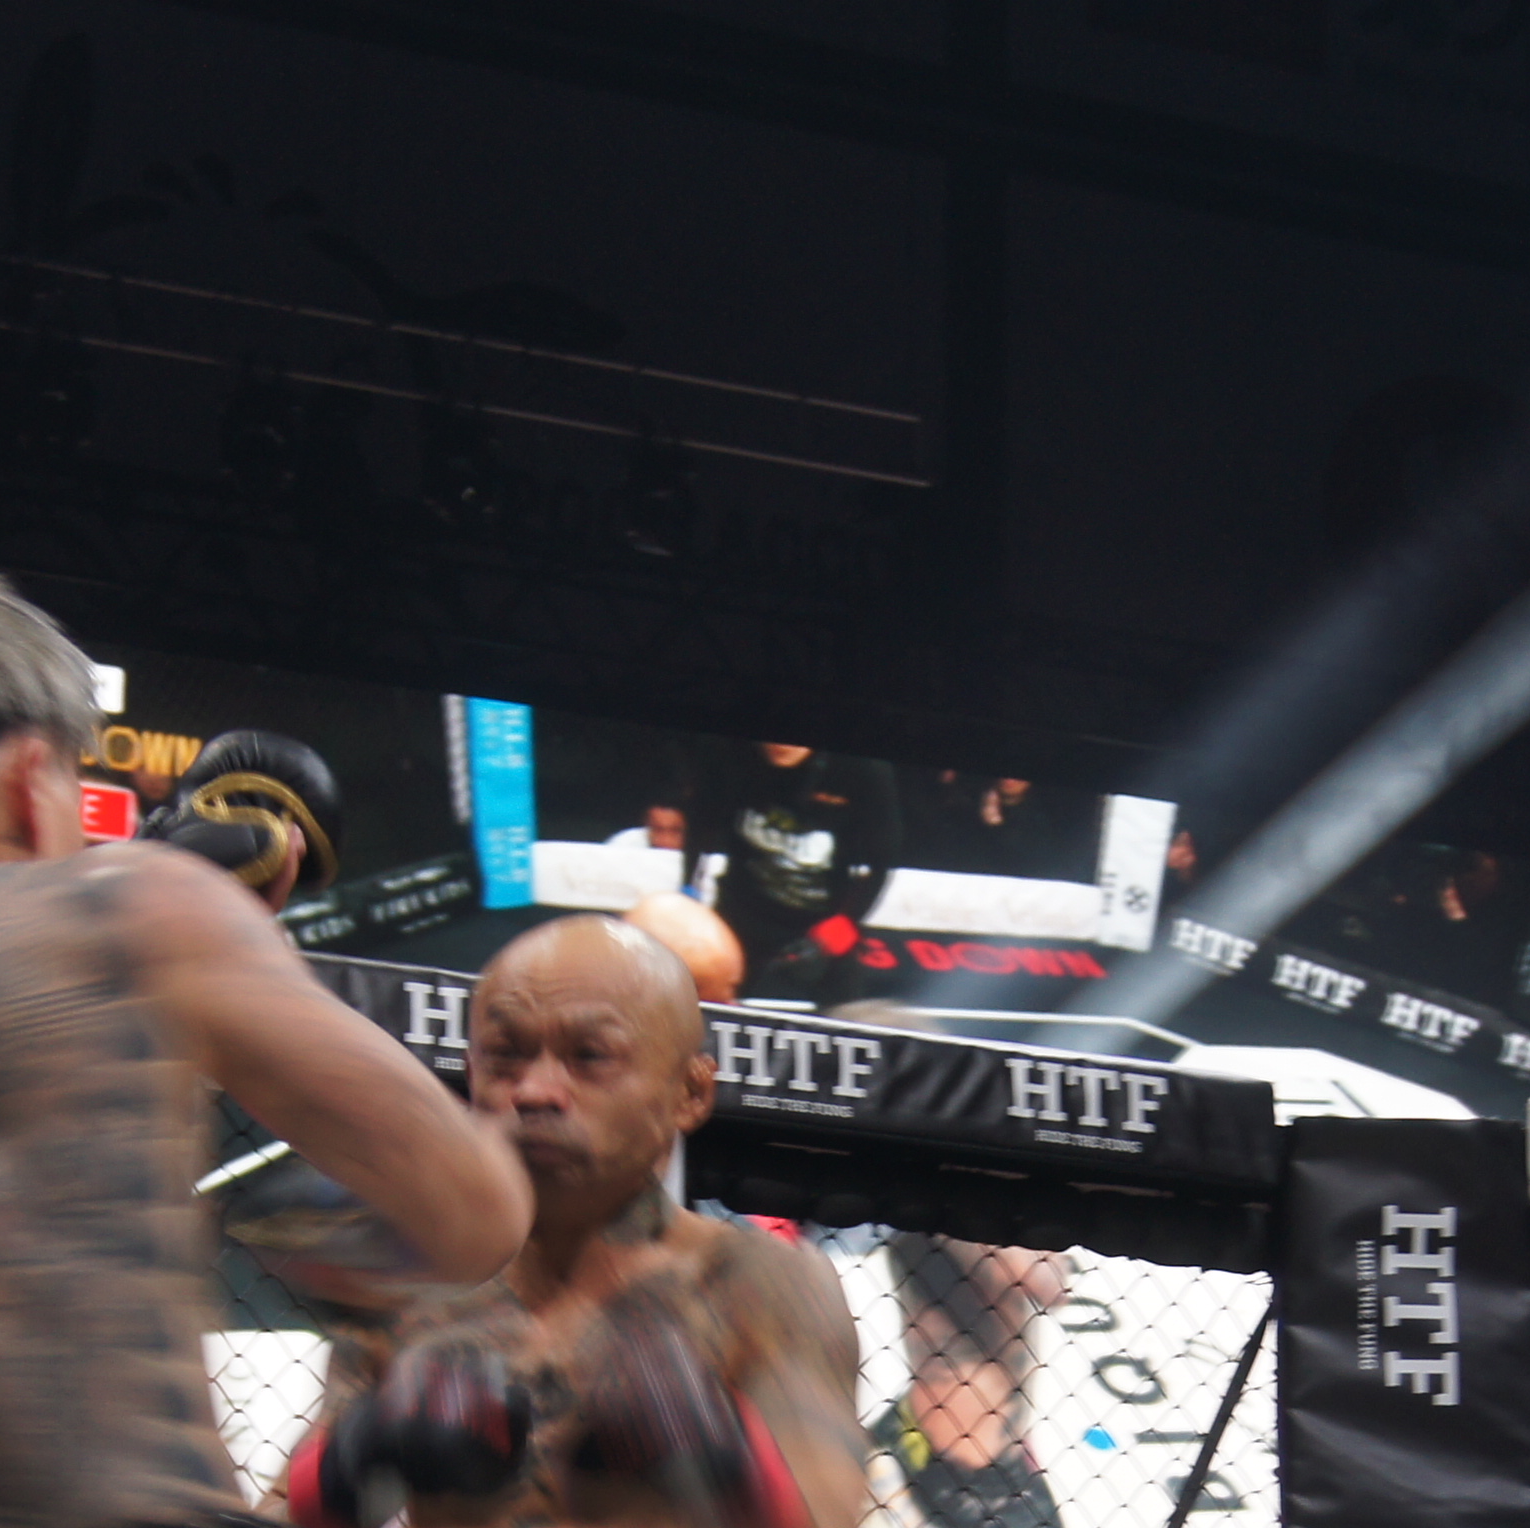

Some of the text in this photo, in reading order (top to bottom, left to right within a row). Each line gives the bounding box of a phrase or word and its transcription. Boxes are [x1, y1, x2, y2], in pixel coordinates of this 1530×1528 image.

[1171, 917, 1258, 969] HTF
[1271, 953, 1367, 1009] HTF
[1380, 992, 1480, 1046] HTF
[710, 1020, 882, 1098] HTF
[1004, 1057, 1168, 1133] HTF
[1380, 1204, 1460, 1406] HTF
